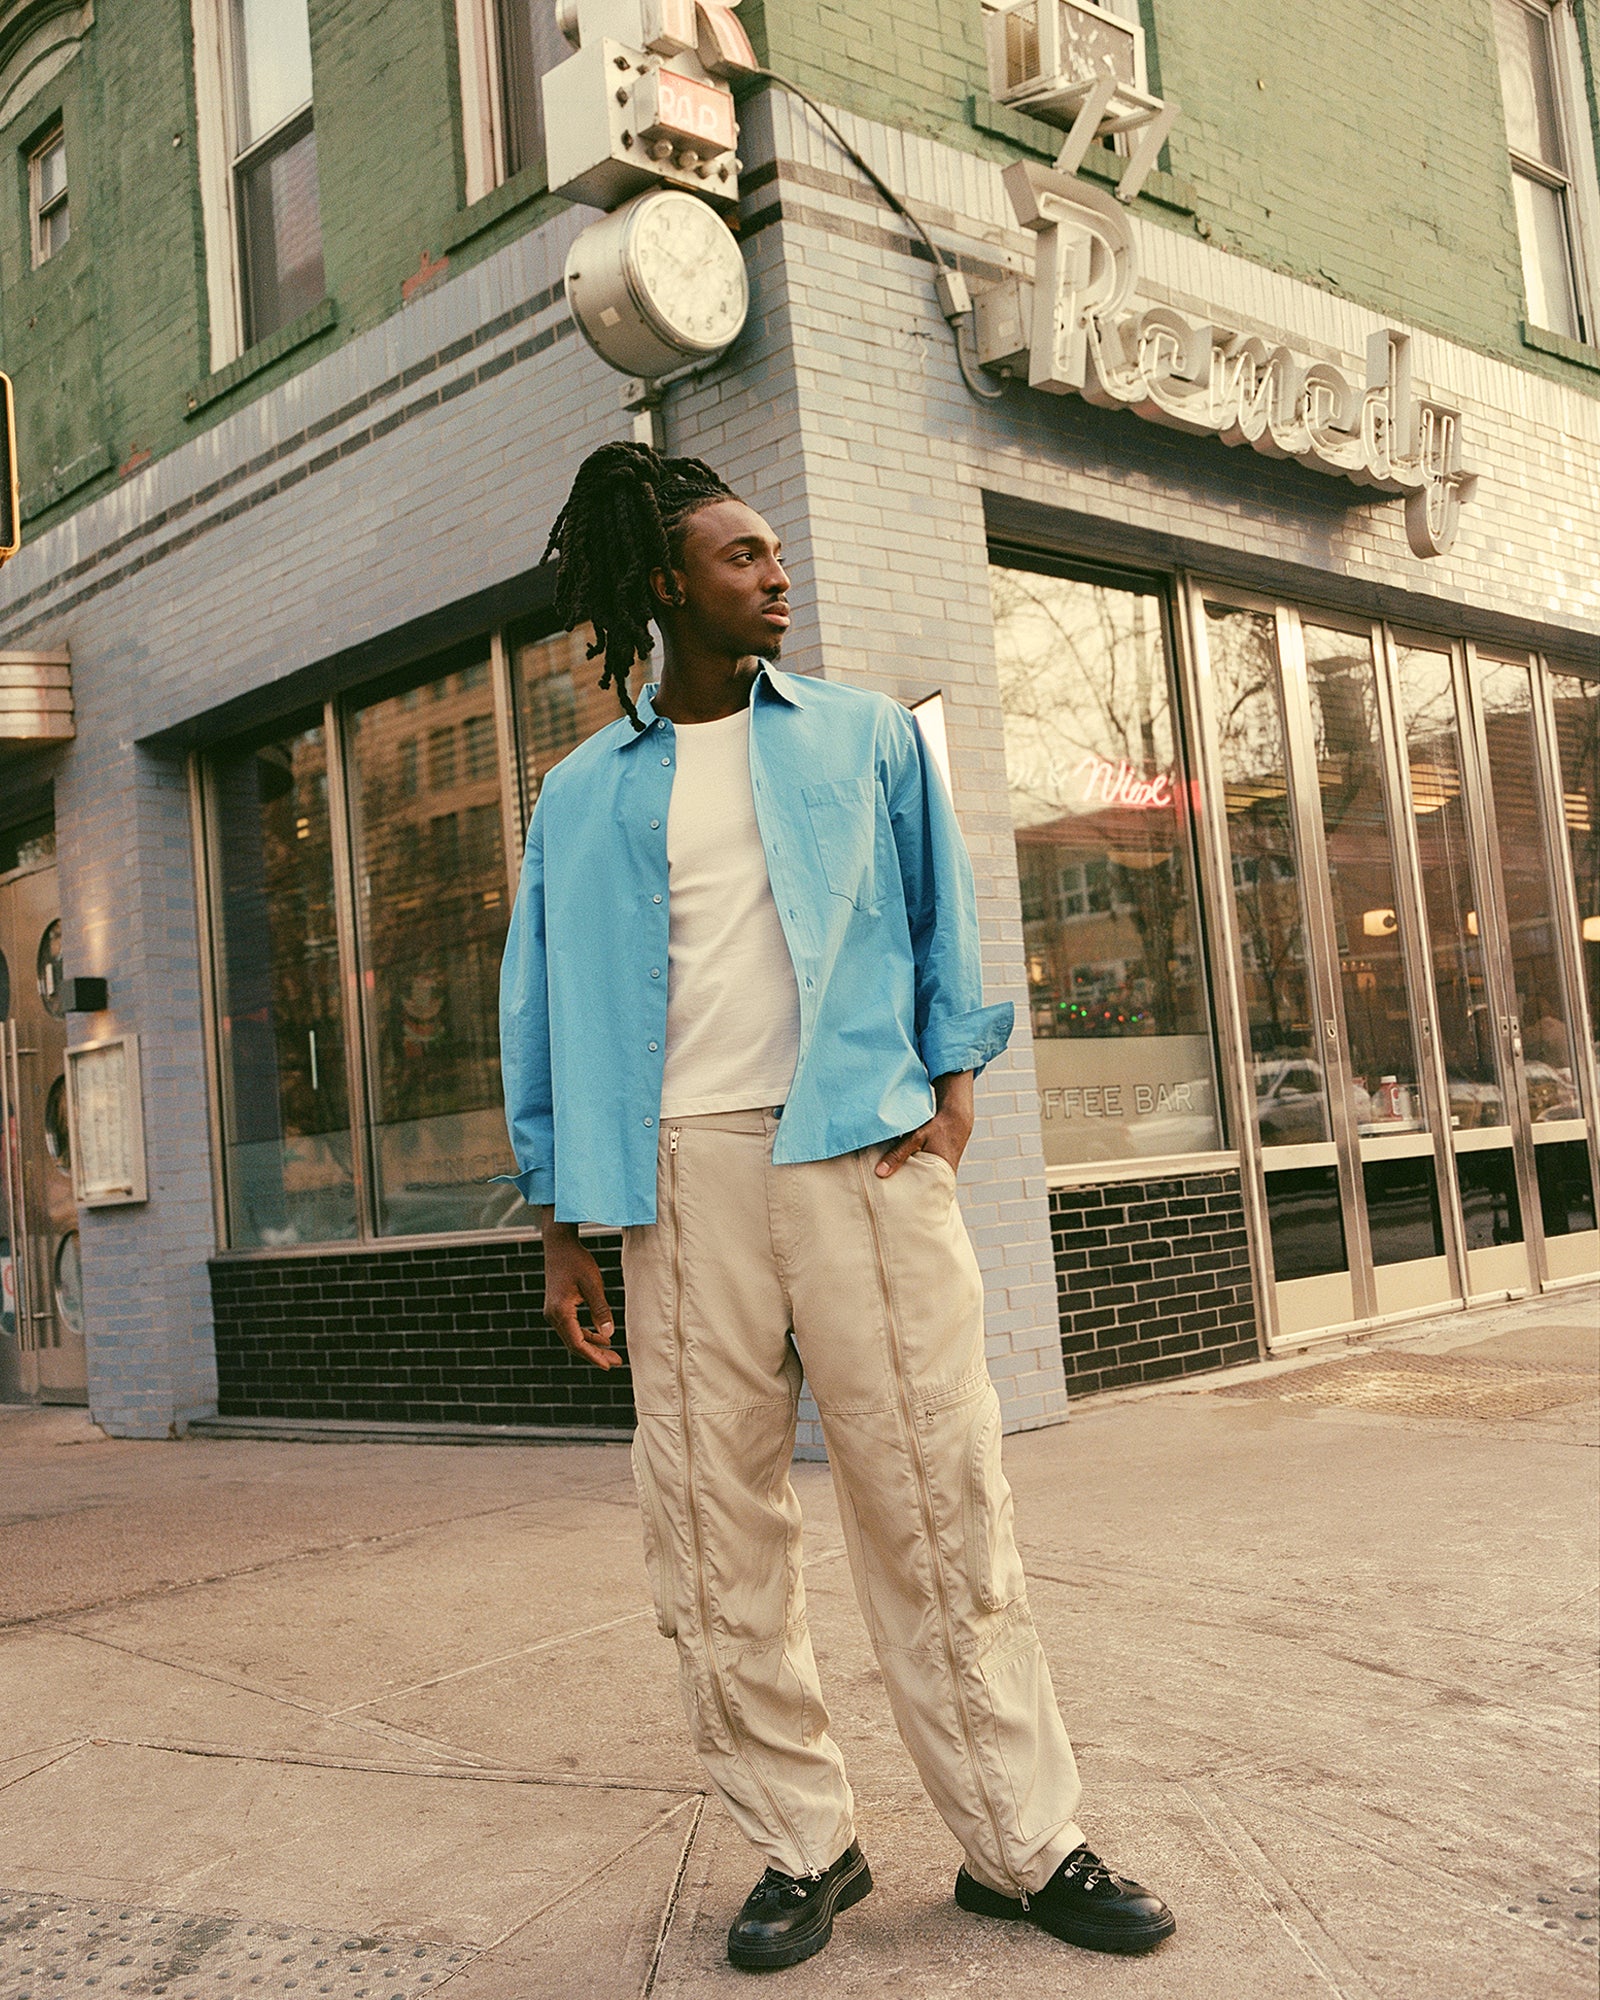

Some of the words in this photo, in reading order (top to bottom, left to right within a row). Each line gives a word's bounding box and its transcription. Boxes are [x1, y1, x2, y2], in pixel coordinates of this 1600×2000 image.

[1002, 159, 1478, 560] Remedy
[1072, 756, 1173, 806] Wine
[1040, 1084, 1123, 1119] FFEE
[1132, 1081, 1194, 1116] BAR
